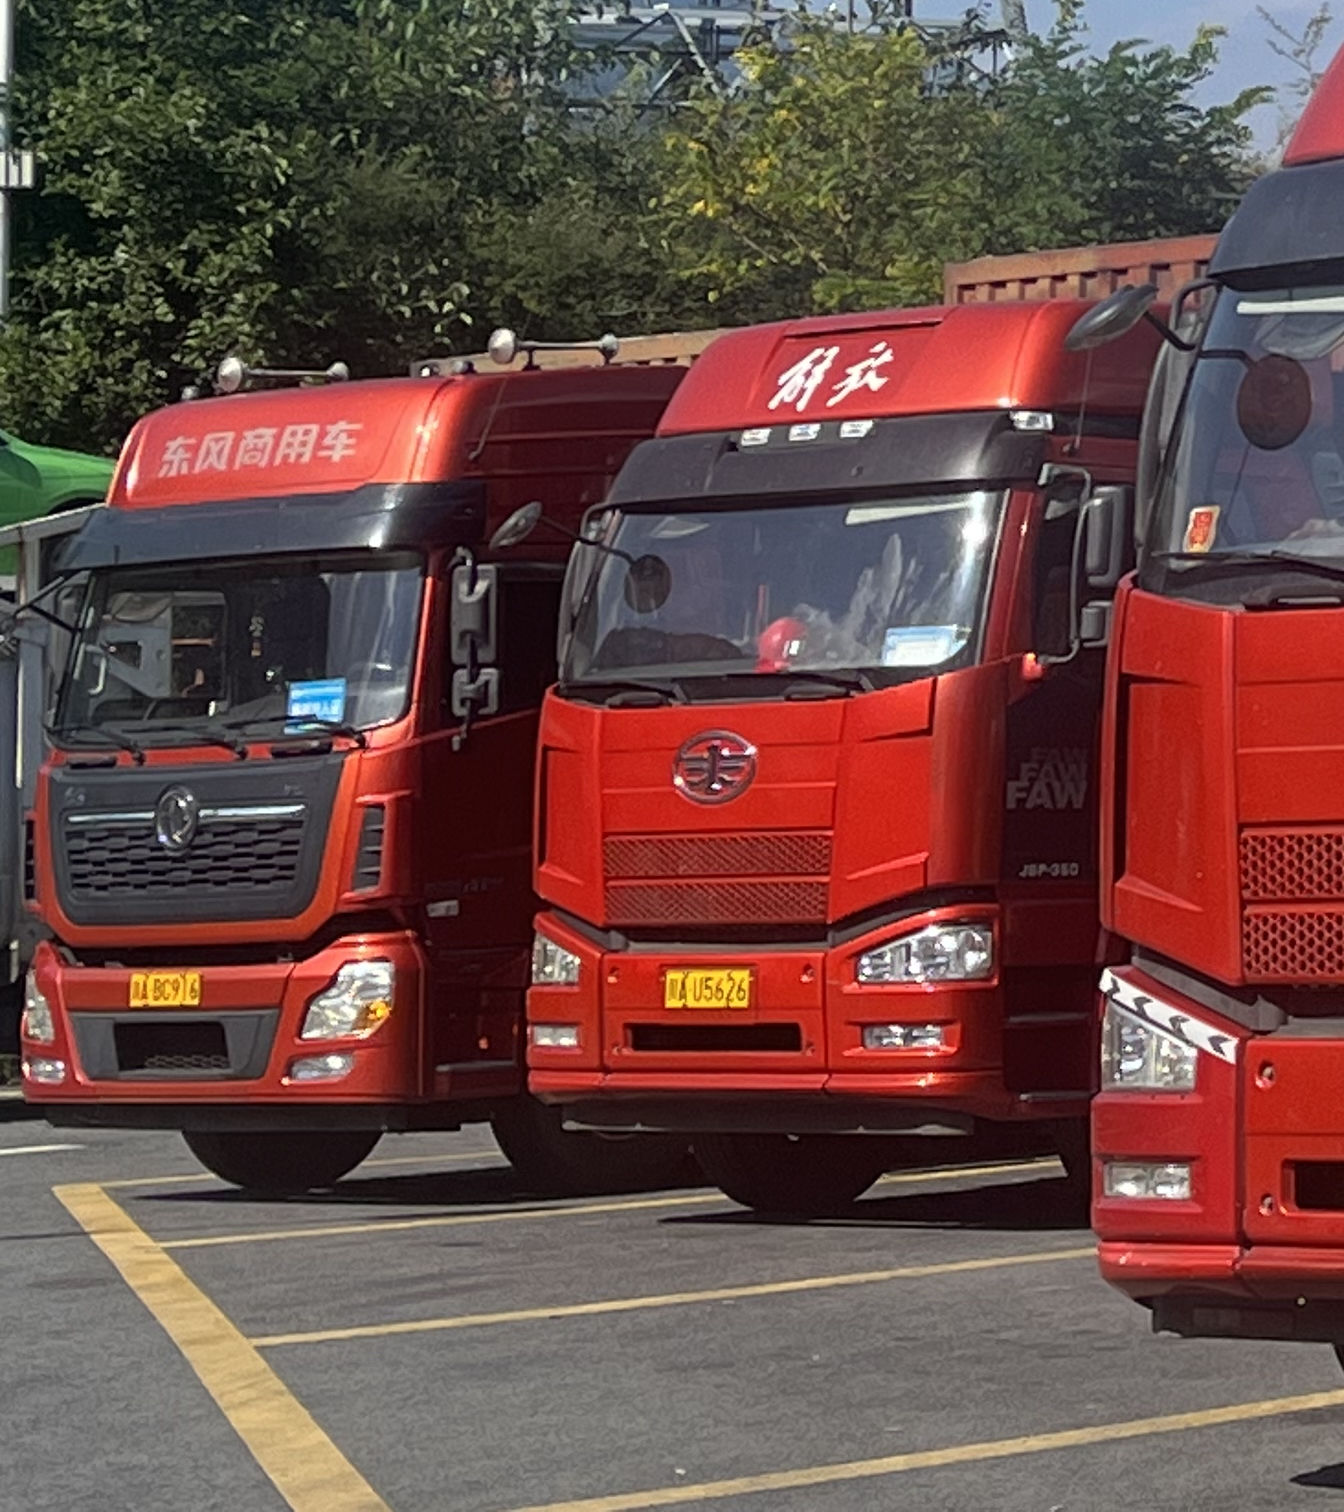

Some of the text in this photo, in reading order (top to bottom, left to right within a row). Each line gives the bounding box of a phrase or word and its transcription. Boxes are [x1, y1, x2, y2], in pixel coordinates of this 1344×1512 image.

[767, 341, 894, 412] 解放
[158, 421, 363, 478] 东风商用车
[1006, 780, 1088, 809] FAW
